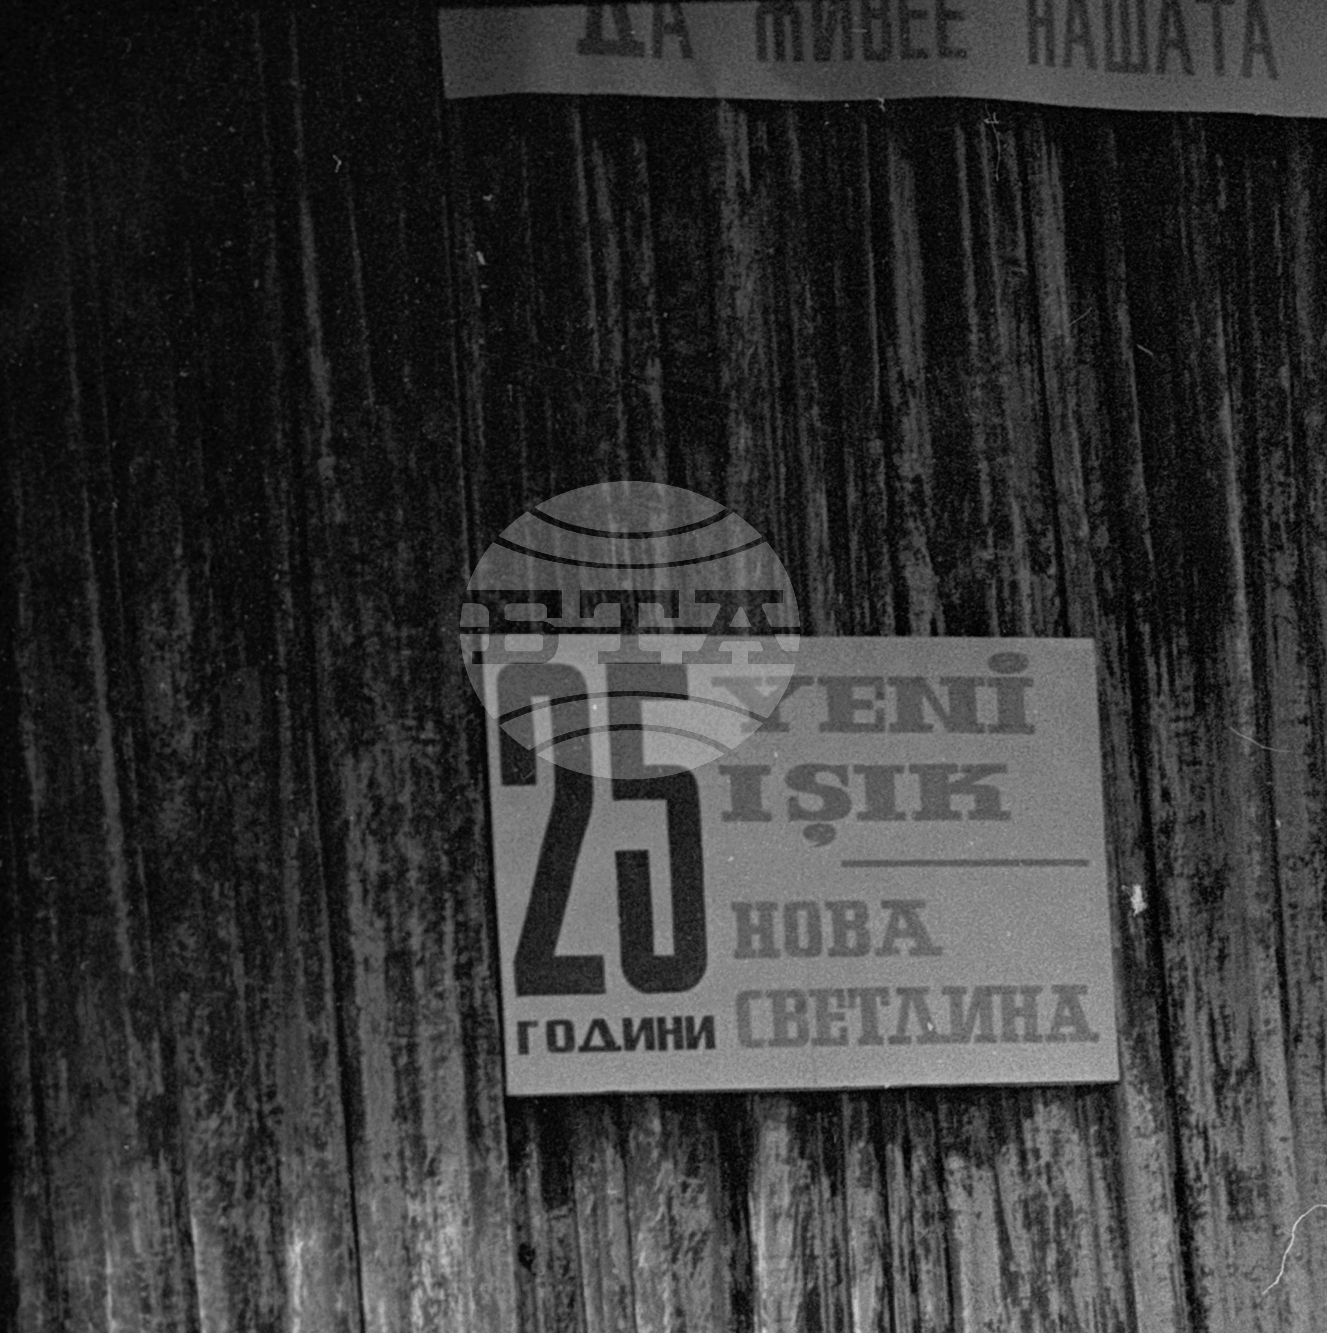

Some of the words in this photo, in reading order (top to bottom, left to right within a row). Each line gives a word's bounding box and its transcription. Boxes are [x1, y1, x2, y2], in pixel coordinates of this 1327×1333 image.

[1026, 0, 1279, 80] НАШАТА
[497, 662, 708, 998] 25
[717, 763, 1013, 848] IŞIK
[732, 900, 943, 960] НОВА
[515, 1013, 717, 1056] ГОДИНИ
[735, 984, 1100, 1050] СВЕТЛИНА
